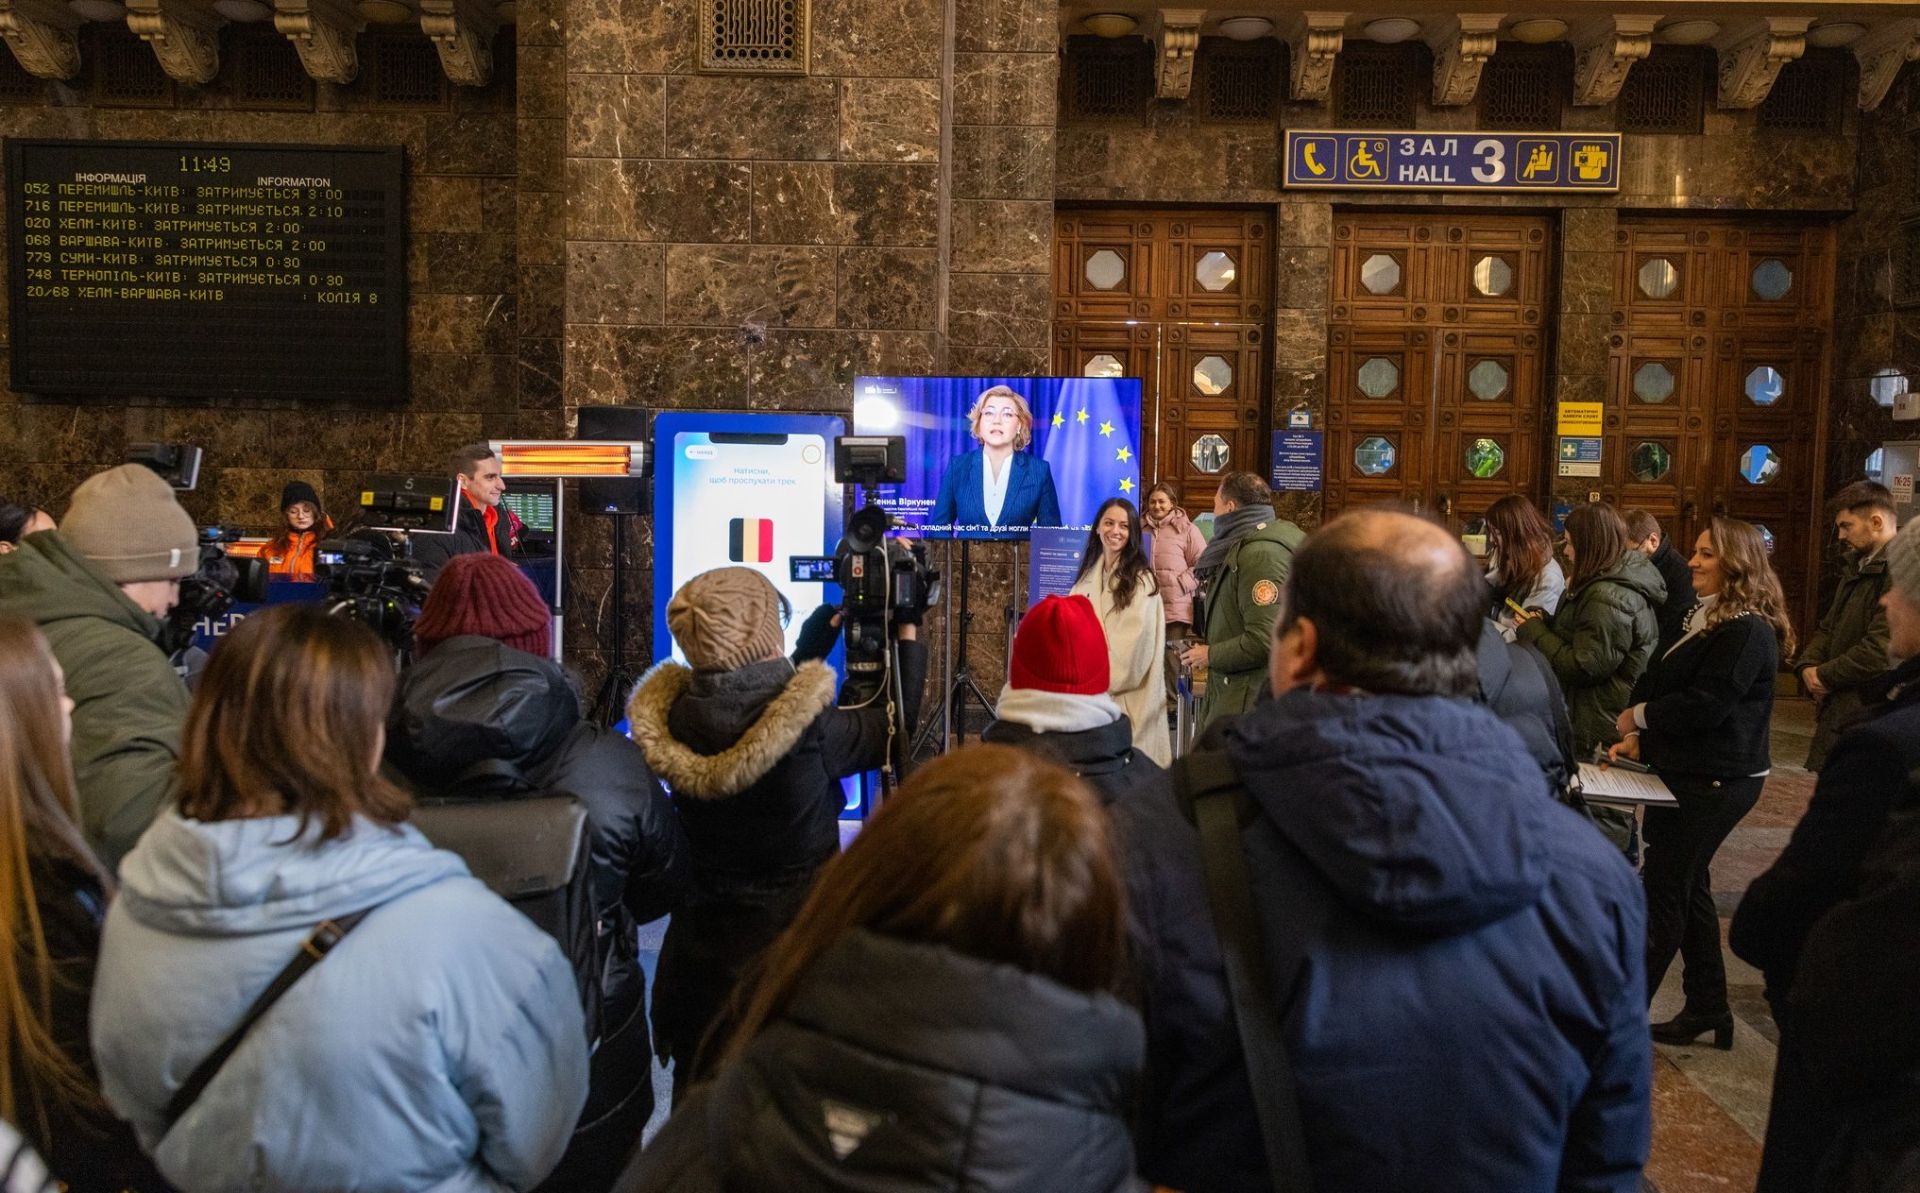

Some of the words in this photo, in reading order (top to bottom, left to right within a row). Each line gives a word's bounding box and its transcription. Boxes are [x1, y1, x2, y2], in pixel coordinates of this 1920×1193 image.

[1400, 138, 1458, 156] ЗАЛ
[179, 156, 231, 173] 11:49
[1471, 139, 1506, 183] 3
[75, 172, 147, 185] ІНФОРМАЦІЯ
[257, 176, 331, 188] INFORMATION
[1399, 165, 1456, 182] HALL
[24, 183, 51, 195] 052
[197, 186, 300, 199] ЗАТРИМУЄТЬСЯ
[308, 189, 343, 200] 3:00
[25, 200, 51, 212] 716
[197, 203, 301, 217] ЗАТРИМУЄТЬСЯ
[308, 206, 343, 217] 2:10
[25, 217, 51, 229] 020
[154, 220, 257, 233] ЗАТРИМУЄТЬСЯ
[265, 222, 300, 234] 2:00
[25, 234, 51, 246] 068
[180, 238, 283, 251] ЗАТРИМУЄТЬСЯ
[292, 240, 326, 251] 2:00
[26, 251, 52, 263] 779
[155, 254, 257, 267] ЗАТРИМУЄТЬСЯ
[266, 256, 300, 268] 0:30
[26, 268, 52, 280] 748
[198, 272, 300, 285] ЗАТРИМУЄТЬСЯ
[26, 285, 70, 298] 20/68
[78, 286, 224, 301] ХЕЛМ-ВАРШАВА-КИЇВ
[317, 291, 361, 304] КОЛІЯ
[369, 293, 378, 304] 8
[405, 478, 415, 490] 5
[898, 497, 936, 507] Віркунен
[920, 523, 952, 533] складний
